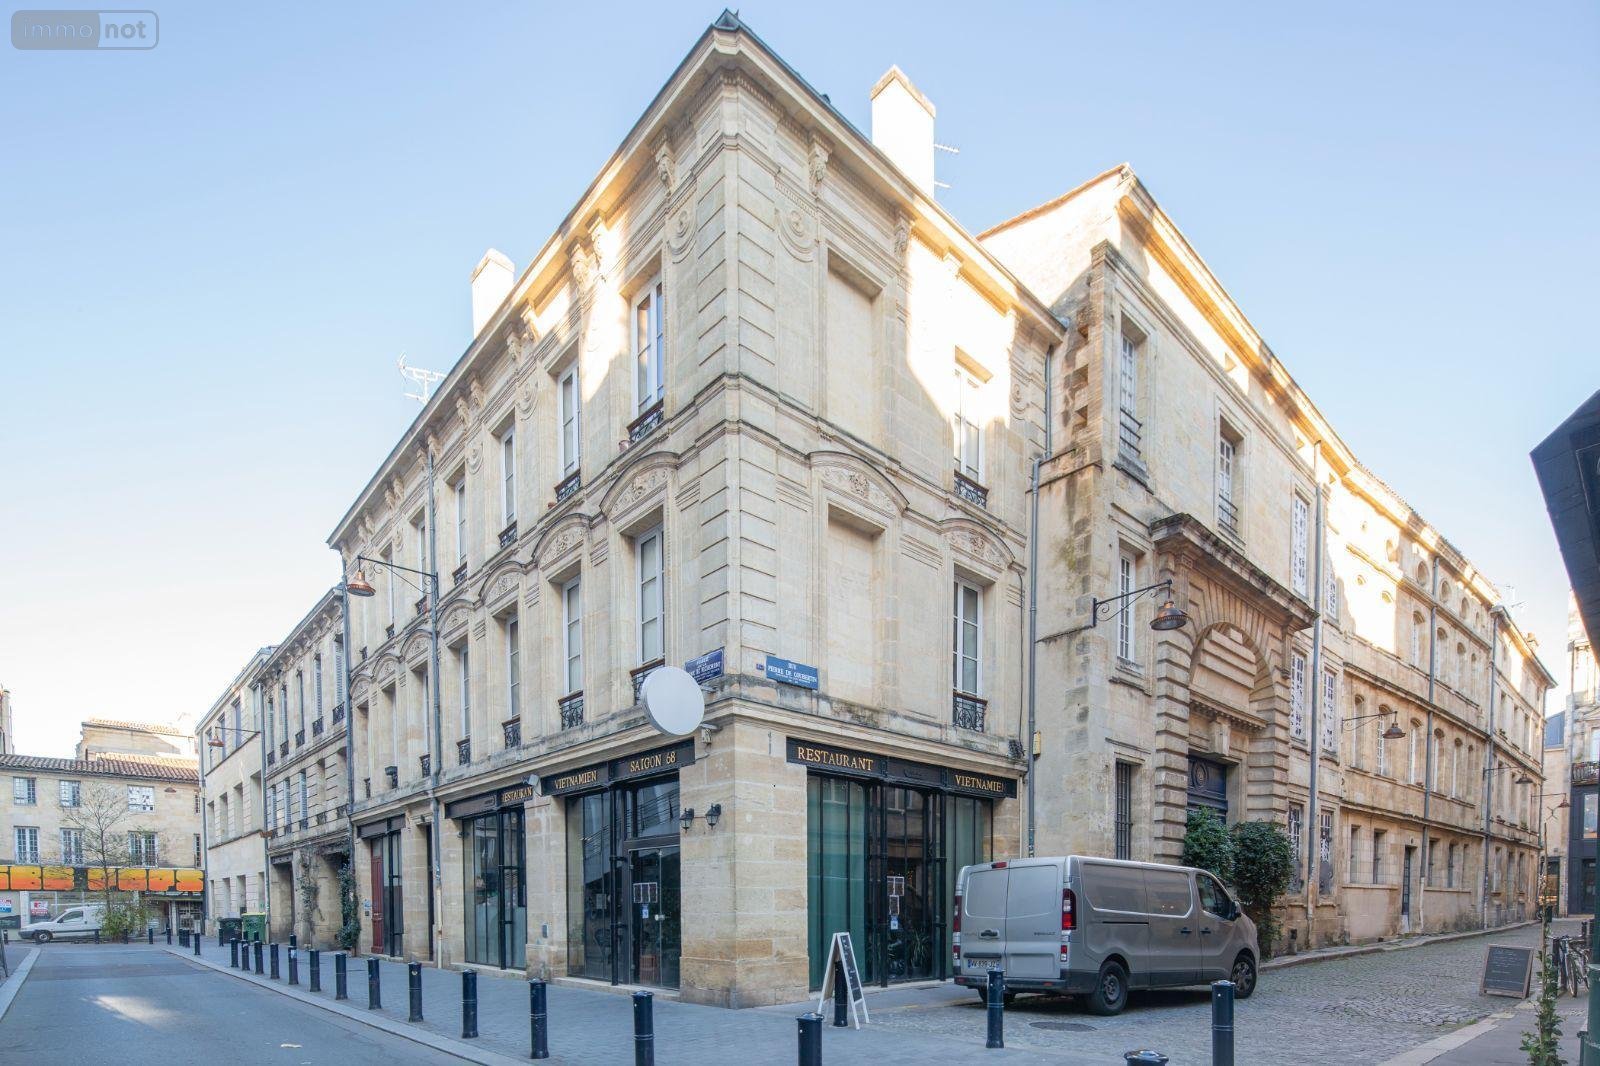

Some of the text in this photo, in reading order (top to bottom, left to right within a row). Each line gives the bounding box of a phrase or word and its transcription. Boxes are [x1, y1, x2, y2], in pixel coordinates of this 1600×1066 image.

[630, 751, 676, 773] SAIGON 68
[797, 746, 874, 771] RESTAURANT
[554, 769, 597, 790] VIETNAMIEN
